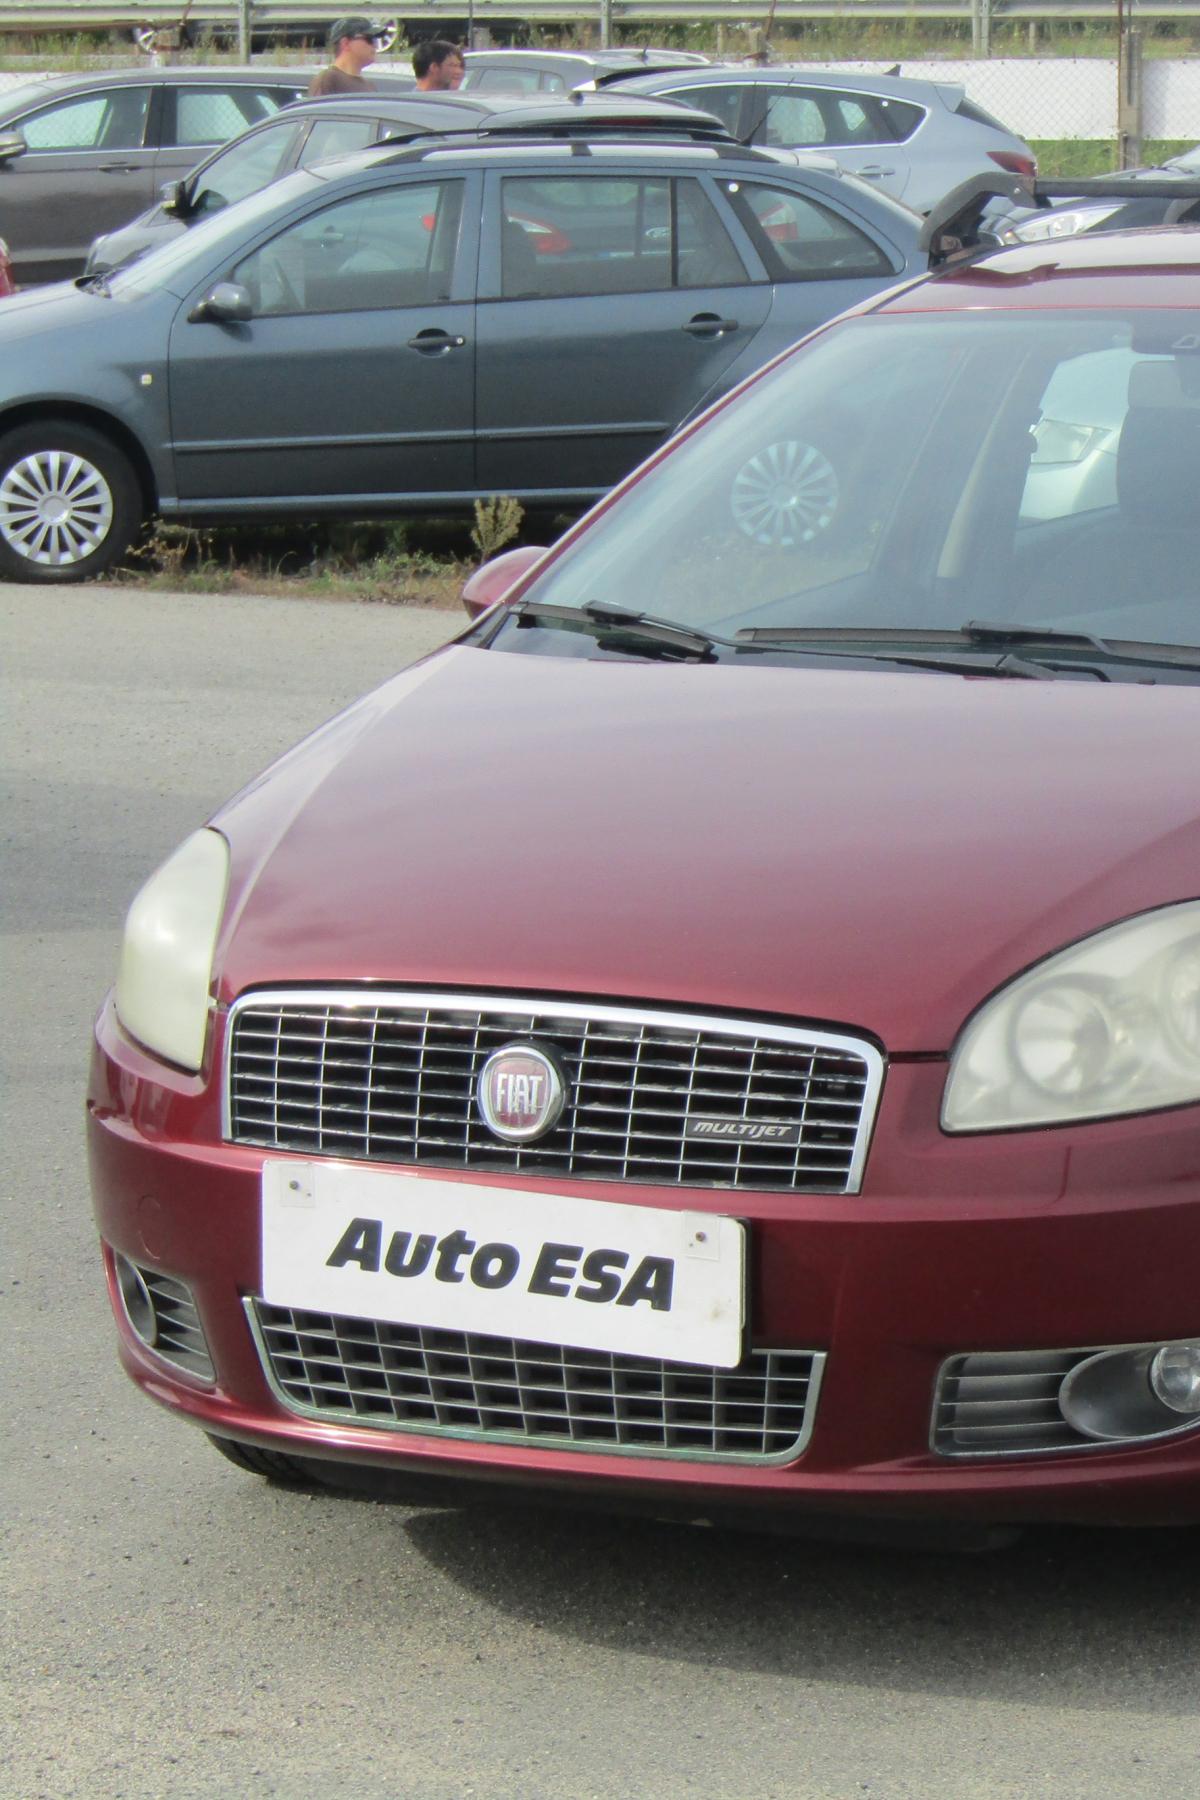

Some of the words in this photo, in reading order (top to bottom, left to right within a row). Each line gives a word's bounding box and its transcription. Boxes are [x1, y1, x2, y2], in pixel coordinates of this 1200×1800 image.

[496, 1073, 544, 1115] FIAT
[693, 1121, 792, 1139] MULTIJET
[325, 1217, 520, 1290] Auto
[527, 1241, 675, 1312] ESA
